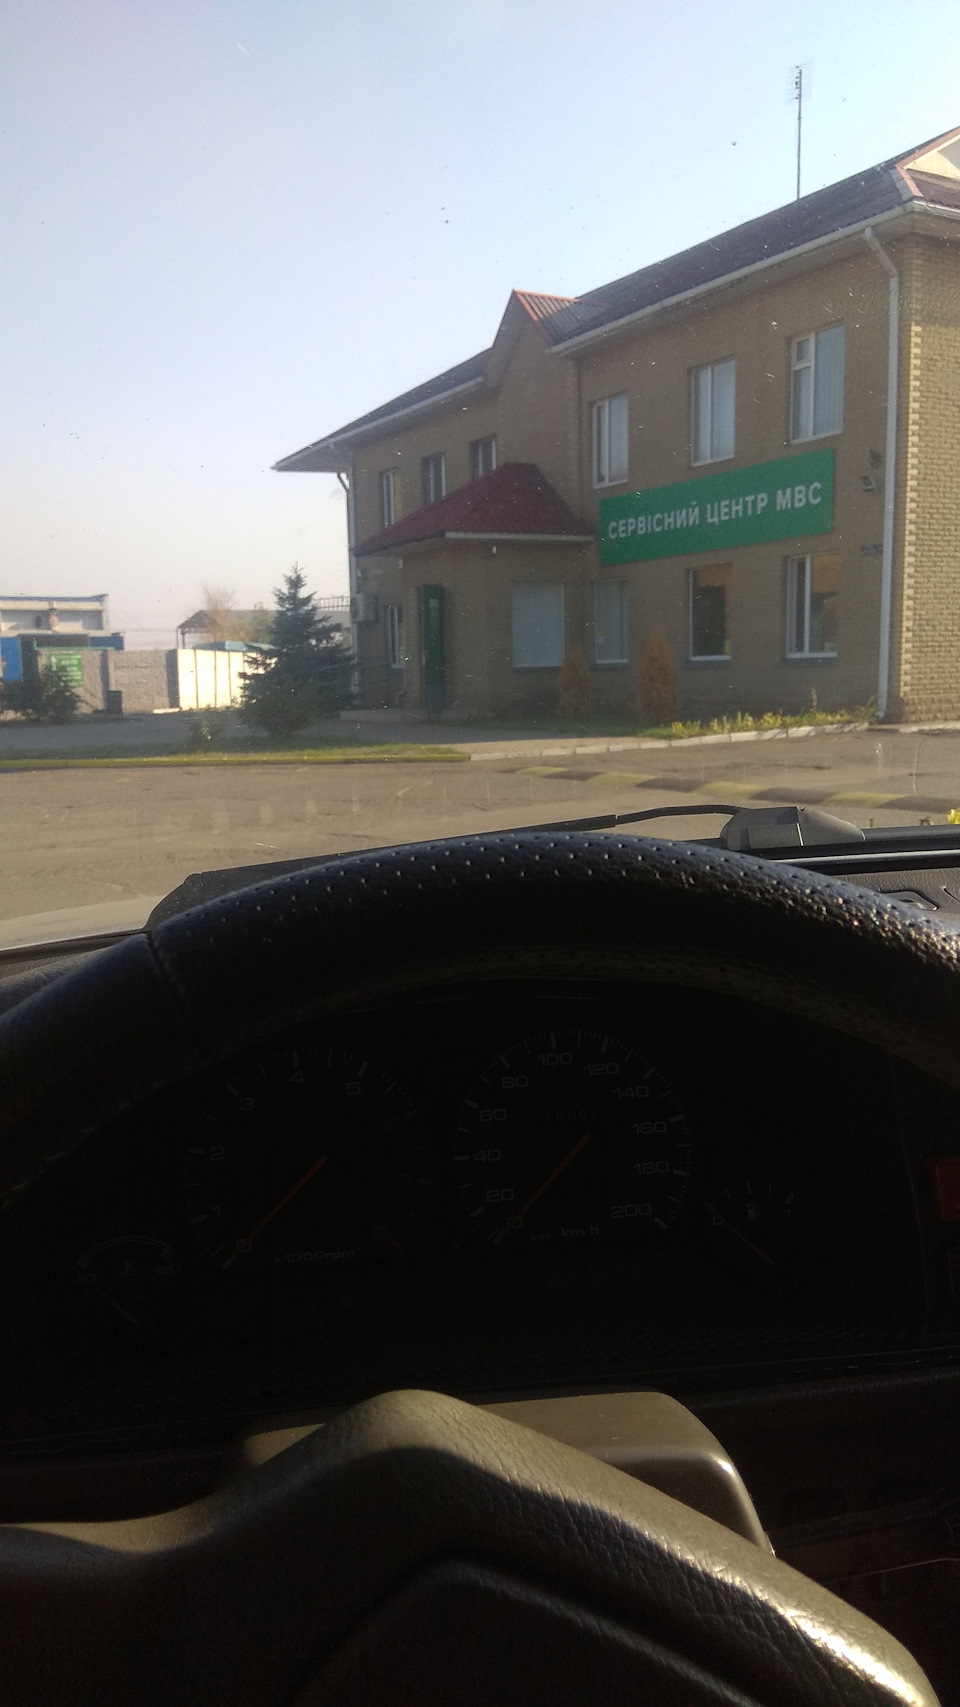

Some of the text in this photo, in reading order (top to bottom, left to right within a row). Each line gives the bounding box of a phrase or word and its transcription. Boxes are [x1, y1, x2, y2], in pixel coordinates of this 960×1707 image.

[608, 482, 822, 539] СЕРВІСНИЙ ЦЕНТР МВС
[537, 1053, 573, 1066] 100
[584, 1062, 620, 1076] 120
[289, 1071, 305, 1085] 4
[502, 1076, 529, 1089] 80
[612, 1085, 650, 1099] 140
[238, 1097, 254, 1111] 3
[479, 1108, 507, 1122] 60
[631, 1121, 668, 1135] 160
[472, 1149, 502, 1163] 40
[633, 1161, 669, 1175] 180
[486, 1188, 515, 1203] 20
[610, 1203, 653, 1219] 200
[560, 1225, 600, 1239] km/h
